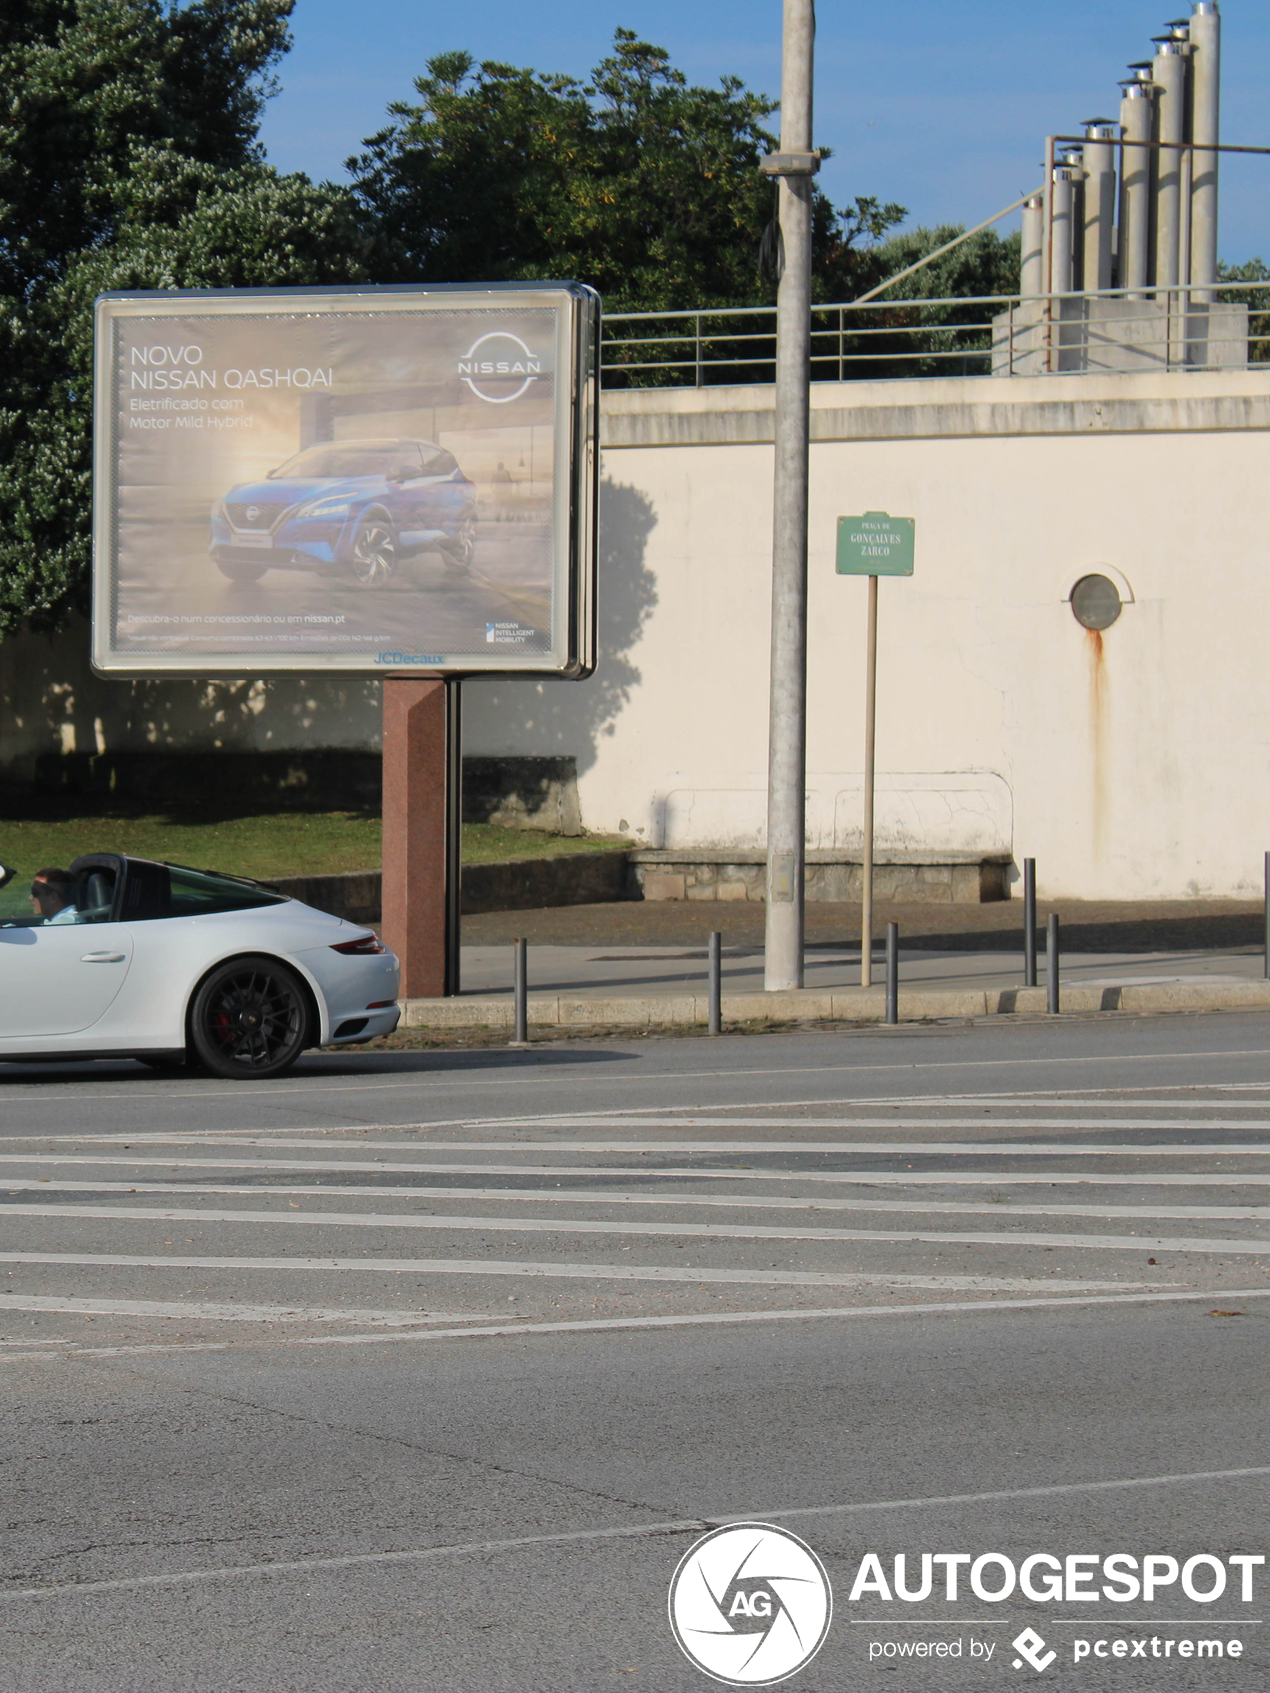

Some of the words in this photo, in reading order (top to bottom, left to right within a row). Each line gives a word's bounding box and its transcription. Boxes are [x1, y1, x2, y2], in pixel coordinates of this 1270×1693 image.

[131, 345, 203, 365] NOVO
[457, 361, 541, 374] NISSAN
[131, 369, 216, 390] NISSAN
[223, 367, 333, 389] QASHQAI
[130, 397, 208, 411] Eletrificado
[211, 398, 244, 410] com
[129, 417, 172, 429] Motor
[175, 415, 204, 428] Mild
[207, 415, 254, 430] Hybrid
[861, 522, 881, 530] PRAÇA
[882, 522, 891, 530] DE
[850, 532, 901, 545] GONÇALVES
[861, 545, 890, 556] ZARCO
[127, 614, 180, 623] Descubra-o
[181, 615, 202, 623] num
[203, 614, 271, 623] concessionário
[273, 615, 286, 623] ou
[287, 615, 303, 623] em
[304, 614, 346, 624] nissan.pt
[374, 652, 445, 664] JCDecaux
